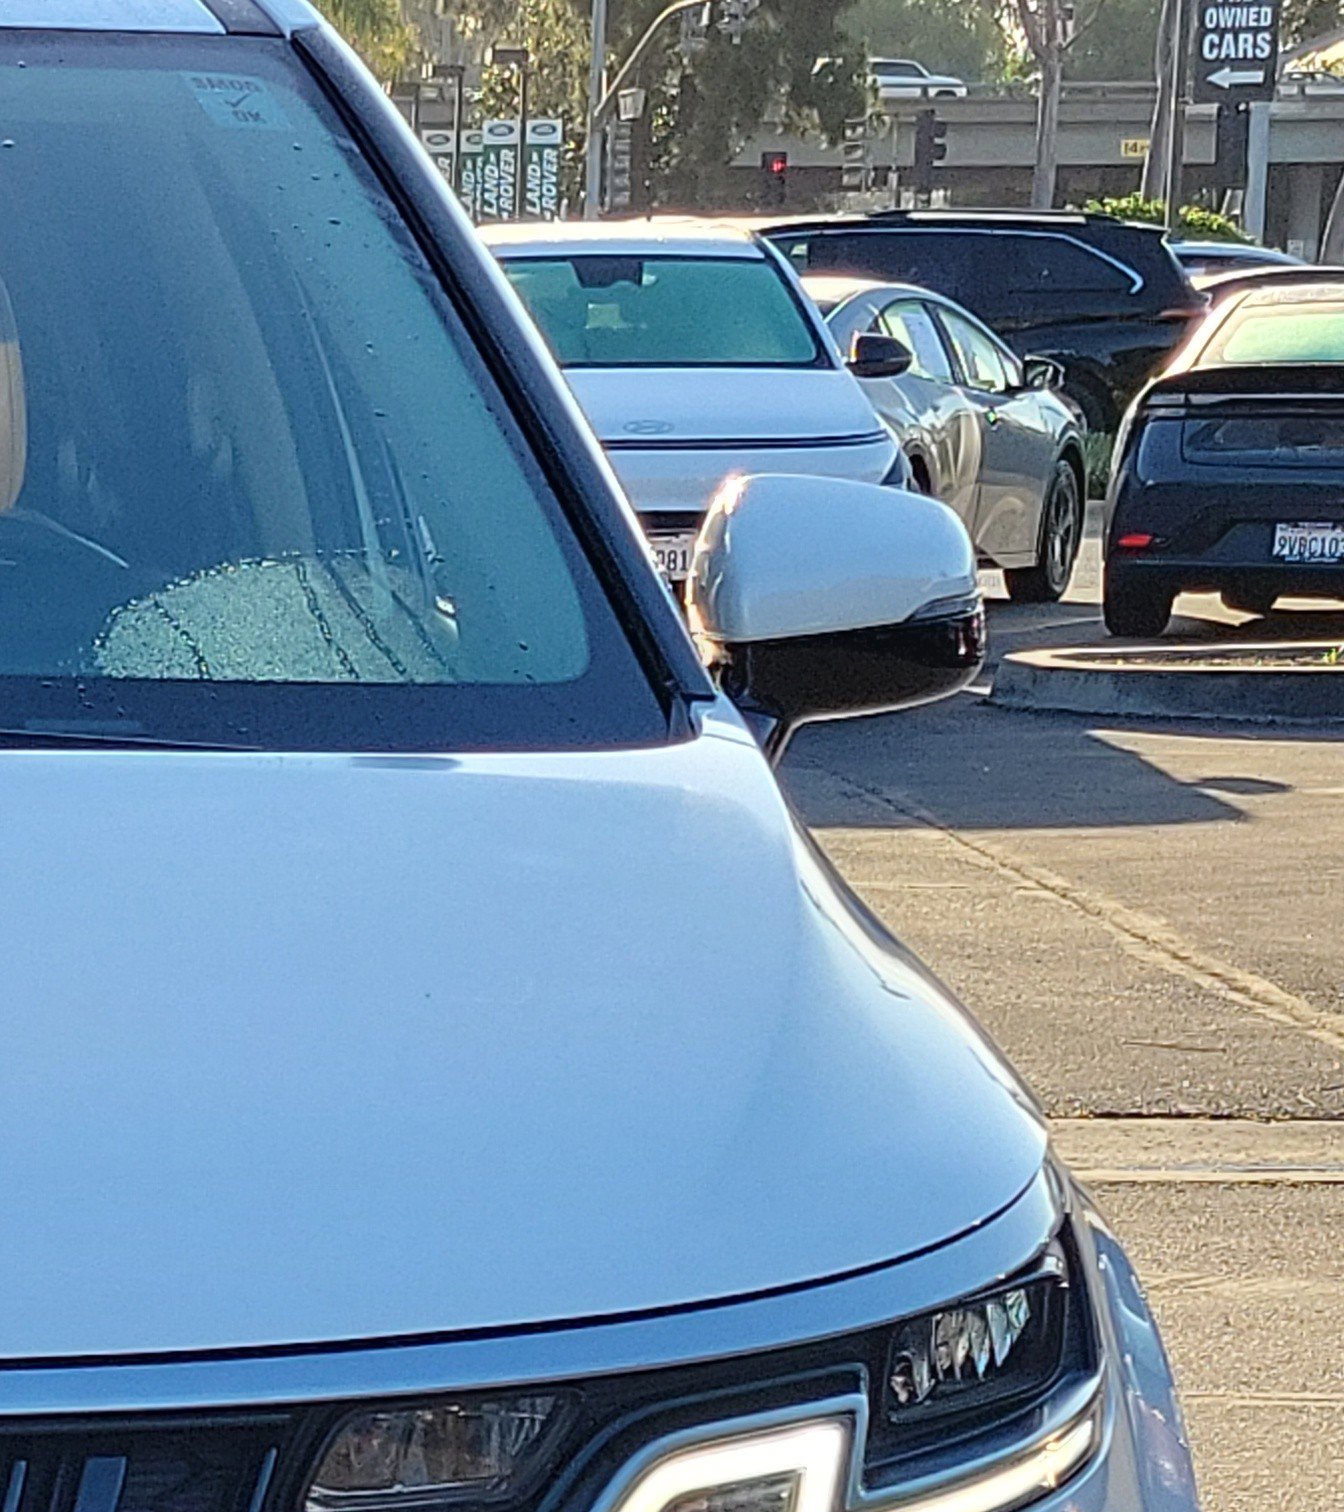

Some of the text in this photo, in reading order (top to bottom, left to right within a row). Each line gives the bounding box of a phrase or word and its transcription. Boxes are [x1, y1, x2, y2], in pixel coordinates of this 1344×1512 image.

[1205, 7, 1272, 28] OWNED
[1203, 32, 1271, 60] CARS
[1277, 536, 1344, 557] 9VBC10
